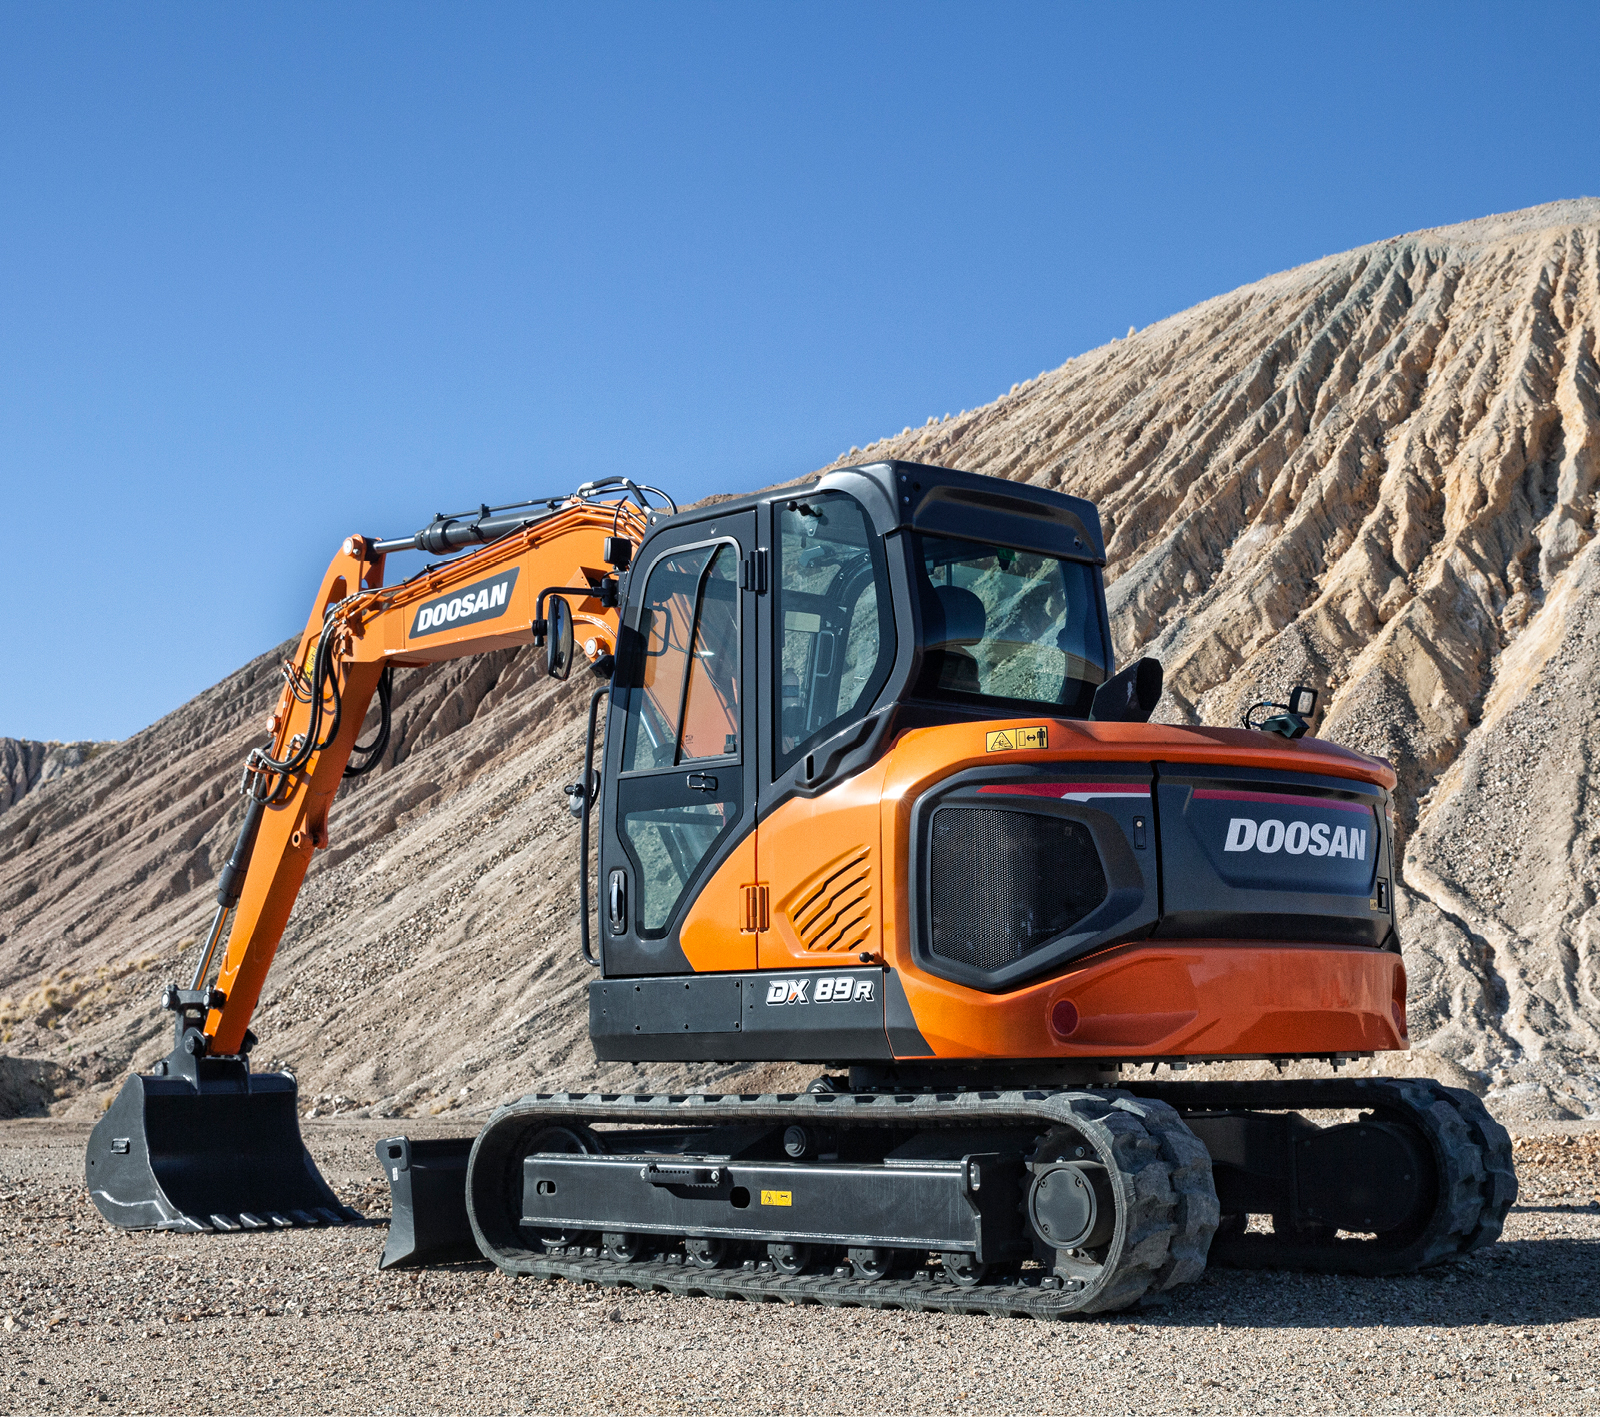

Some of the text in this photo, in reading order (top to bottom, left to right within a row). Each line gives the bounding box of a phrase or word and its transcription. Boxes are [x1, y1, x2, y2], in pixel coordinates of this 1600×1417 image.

[417, 581, 508, 632] DOOSAN
[1224, 818, 1366, 861] DOOSAN
[766, 979, 810, 1006] DX
